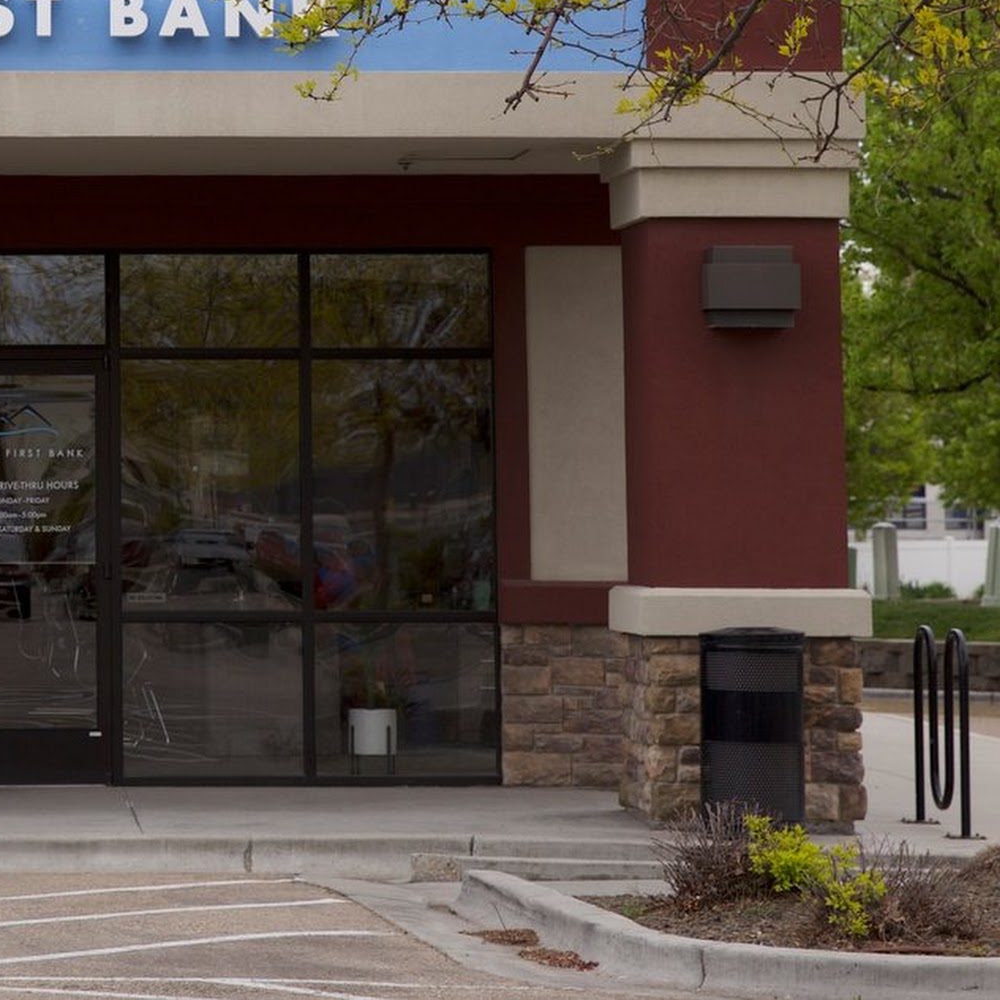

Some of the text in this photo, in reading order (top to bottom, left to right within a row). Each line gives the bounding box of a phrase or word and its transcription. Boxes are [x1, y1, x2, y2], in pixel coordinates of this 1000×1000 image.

[6, 449, 41, 458] FIRST
[49, 449, 85, 458] BANK
[46, 480, 80, 490] HOURS
